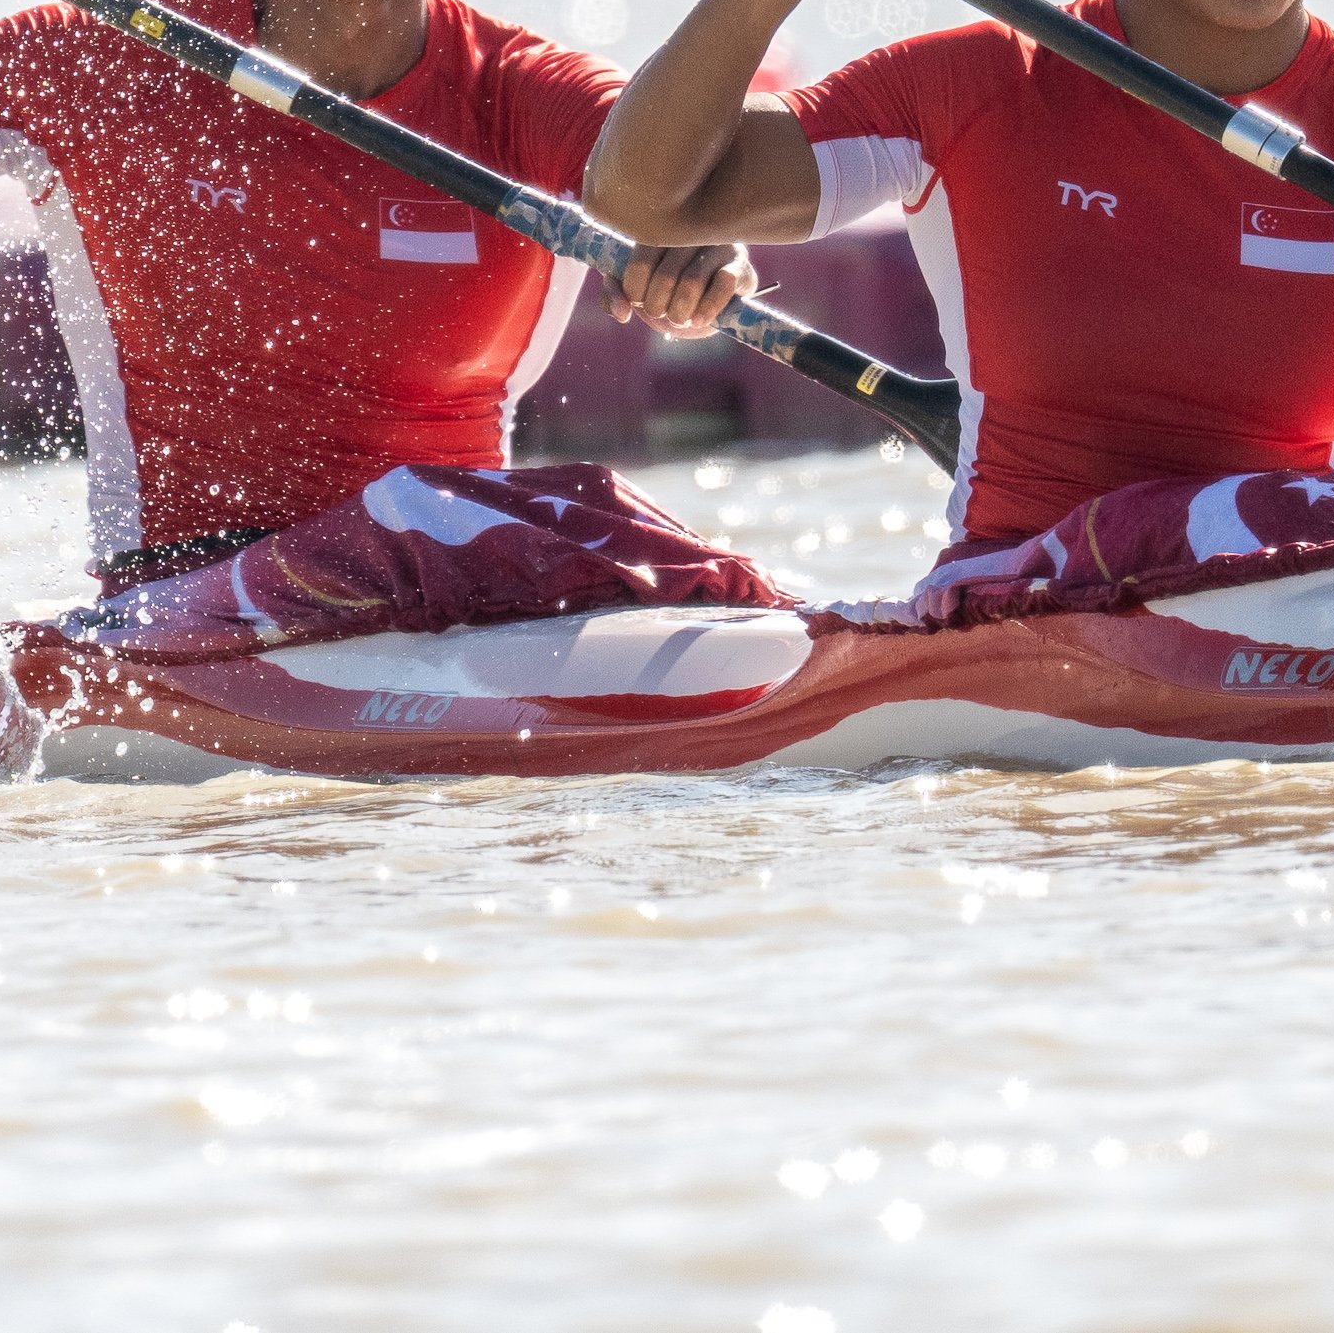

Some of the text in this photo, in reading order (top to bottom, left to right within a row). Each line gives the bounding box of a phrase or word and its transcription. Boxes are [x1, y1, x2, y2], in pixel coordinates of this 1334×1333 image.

[185, 178, 248, 214] TYR
[1057, 179, 1118, 219] TYR
[359, 691, 455, 725] NELO
